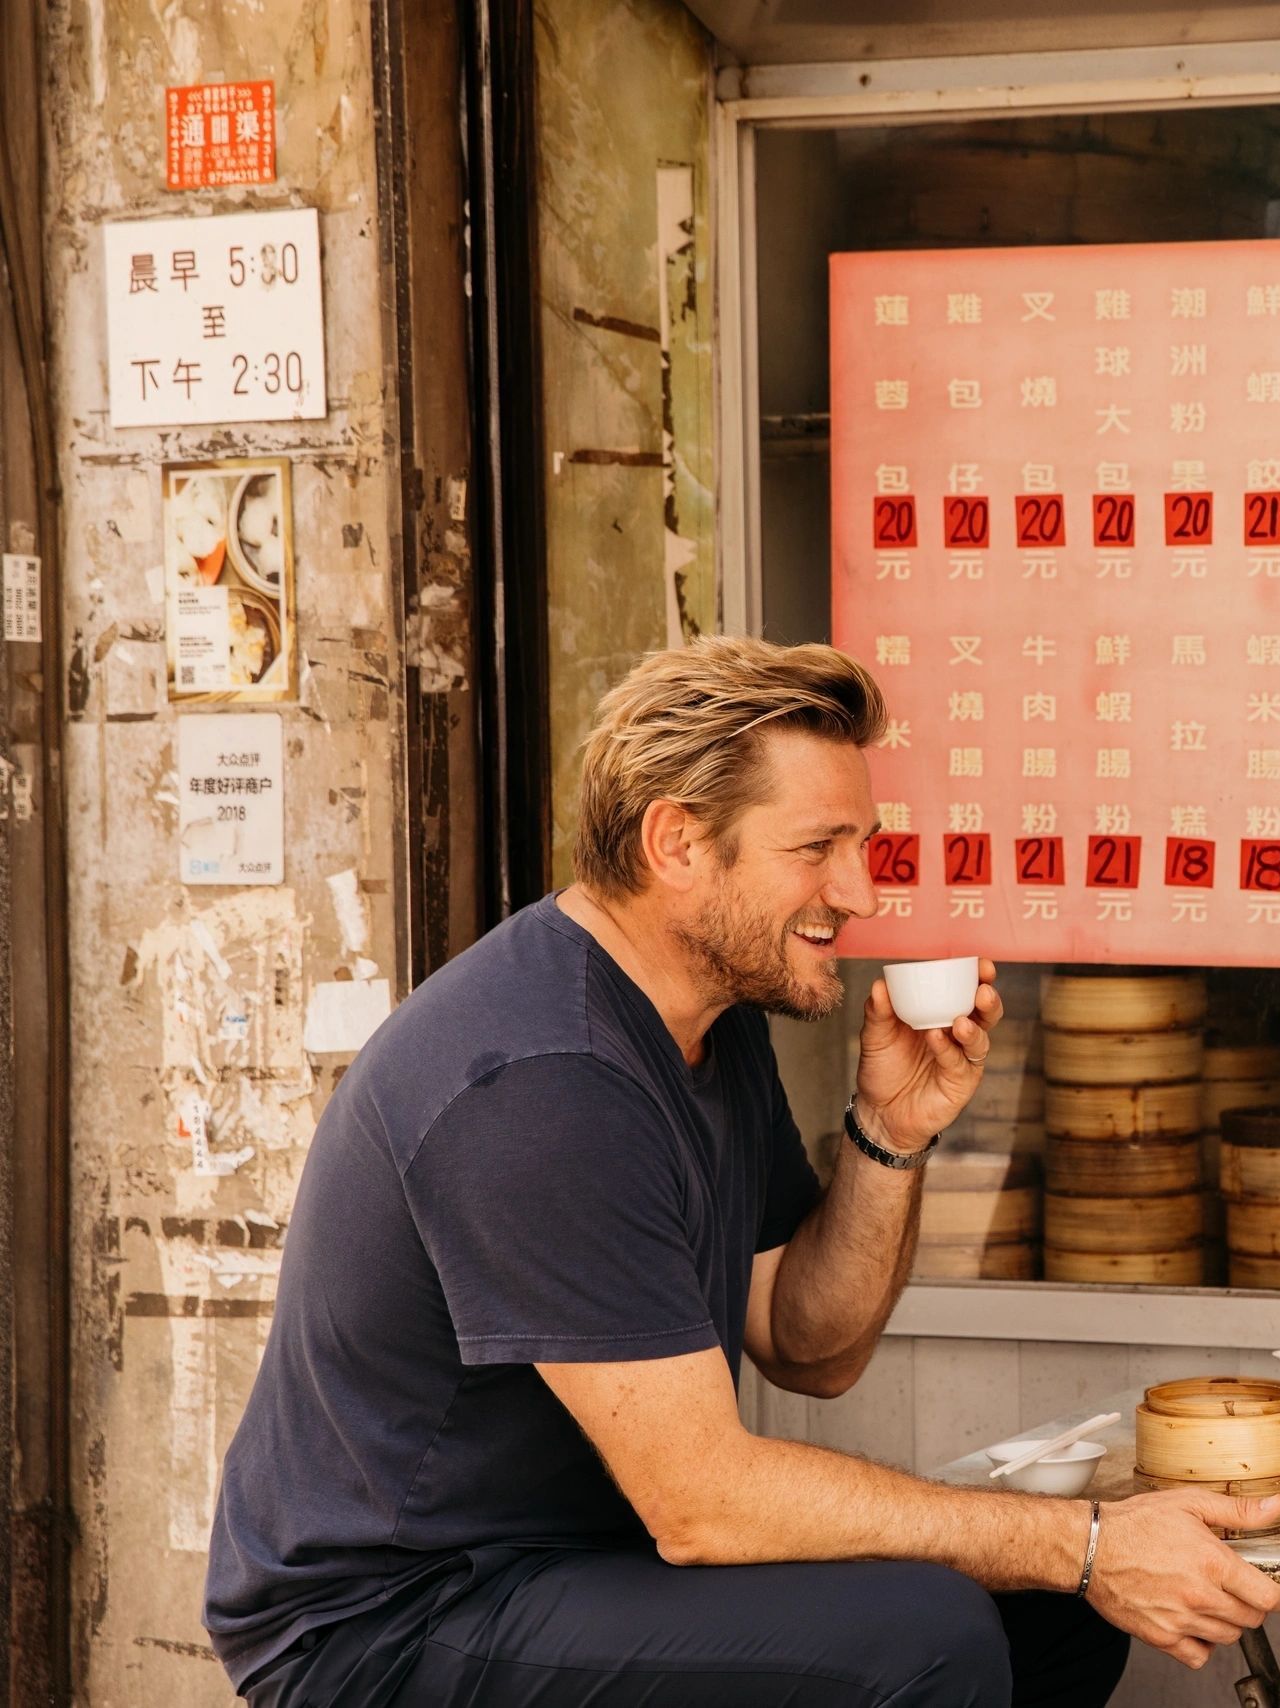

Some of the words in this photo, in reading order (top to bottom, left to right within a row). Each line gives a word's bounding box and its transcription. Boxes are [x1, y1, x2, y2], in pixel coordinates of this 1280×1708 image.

[129, 250, 200, 294] 晨早
[202, 305, 226, 338] 至
[130, 357, 202, 400] 下午
[232, 351, 303, 394] 2:30
[946, 293, 983, 495] 雞包仔
[1020, 291, 1056, 493] 叉燒包
[1095, 289, 1130, 491] 雞球大包
[1170, 287, 1205, 490] 潮洲粉果
[877, 500, 912, 541] 20
[950, 498, 986, 543] 20
[1021, 498, 1060, 541] 20
[1097, 496, 1132, 542] 20
[1172, 495, 1209, 537] 20
[1248, 495, 1277, 537] 21
[876, 551, 911, 581] 元
[949, 551, 984, 580] 元
[1023, 550, 1058, 579] 元
[1098, 550, 1131, 578] 元
[1172, 549, 1207, 578] 元
[875, 635, 911, 833] 糯米雞
[948, 635, 984, 833] 叉燒腸粉
[1021, 635, 1056, 835] 牛肉腸粉
[1095, 635, 1130, 835] 鮮蝦腸粉
[1170, 635, 1206, 836] 馬拉糕
[217, 753, 260, 767] 大众点评
[190, 777, 273, 795] 年度好评商户
[217, 806, 247, 822] 2018
[872, 835, 914, 884] 26
[948, 835, 982, 882] 21
[1020, 837, 1054, 879] 21
[1093, 836, 1130, 884] 21
[1172, 843, 1207, 881] 18
[878, 889, 913, 918] 元
[950, 890, 985, 919] 元
[1023, 891, 1058, 920] 元
[1097, 892, 1132, 921] 元
[1172, 894, 1207, 923] 元
